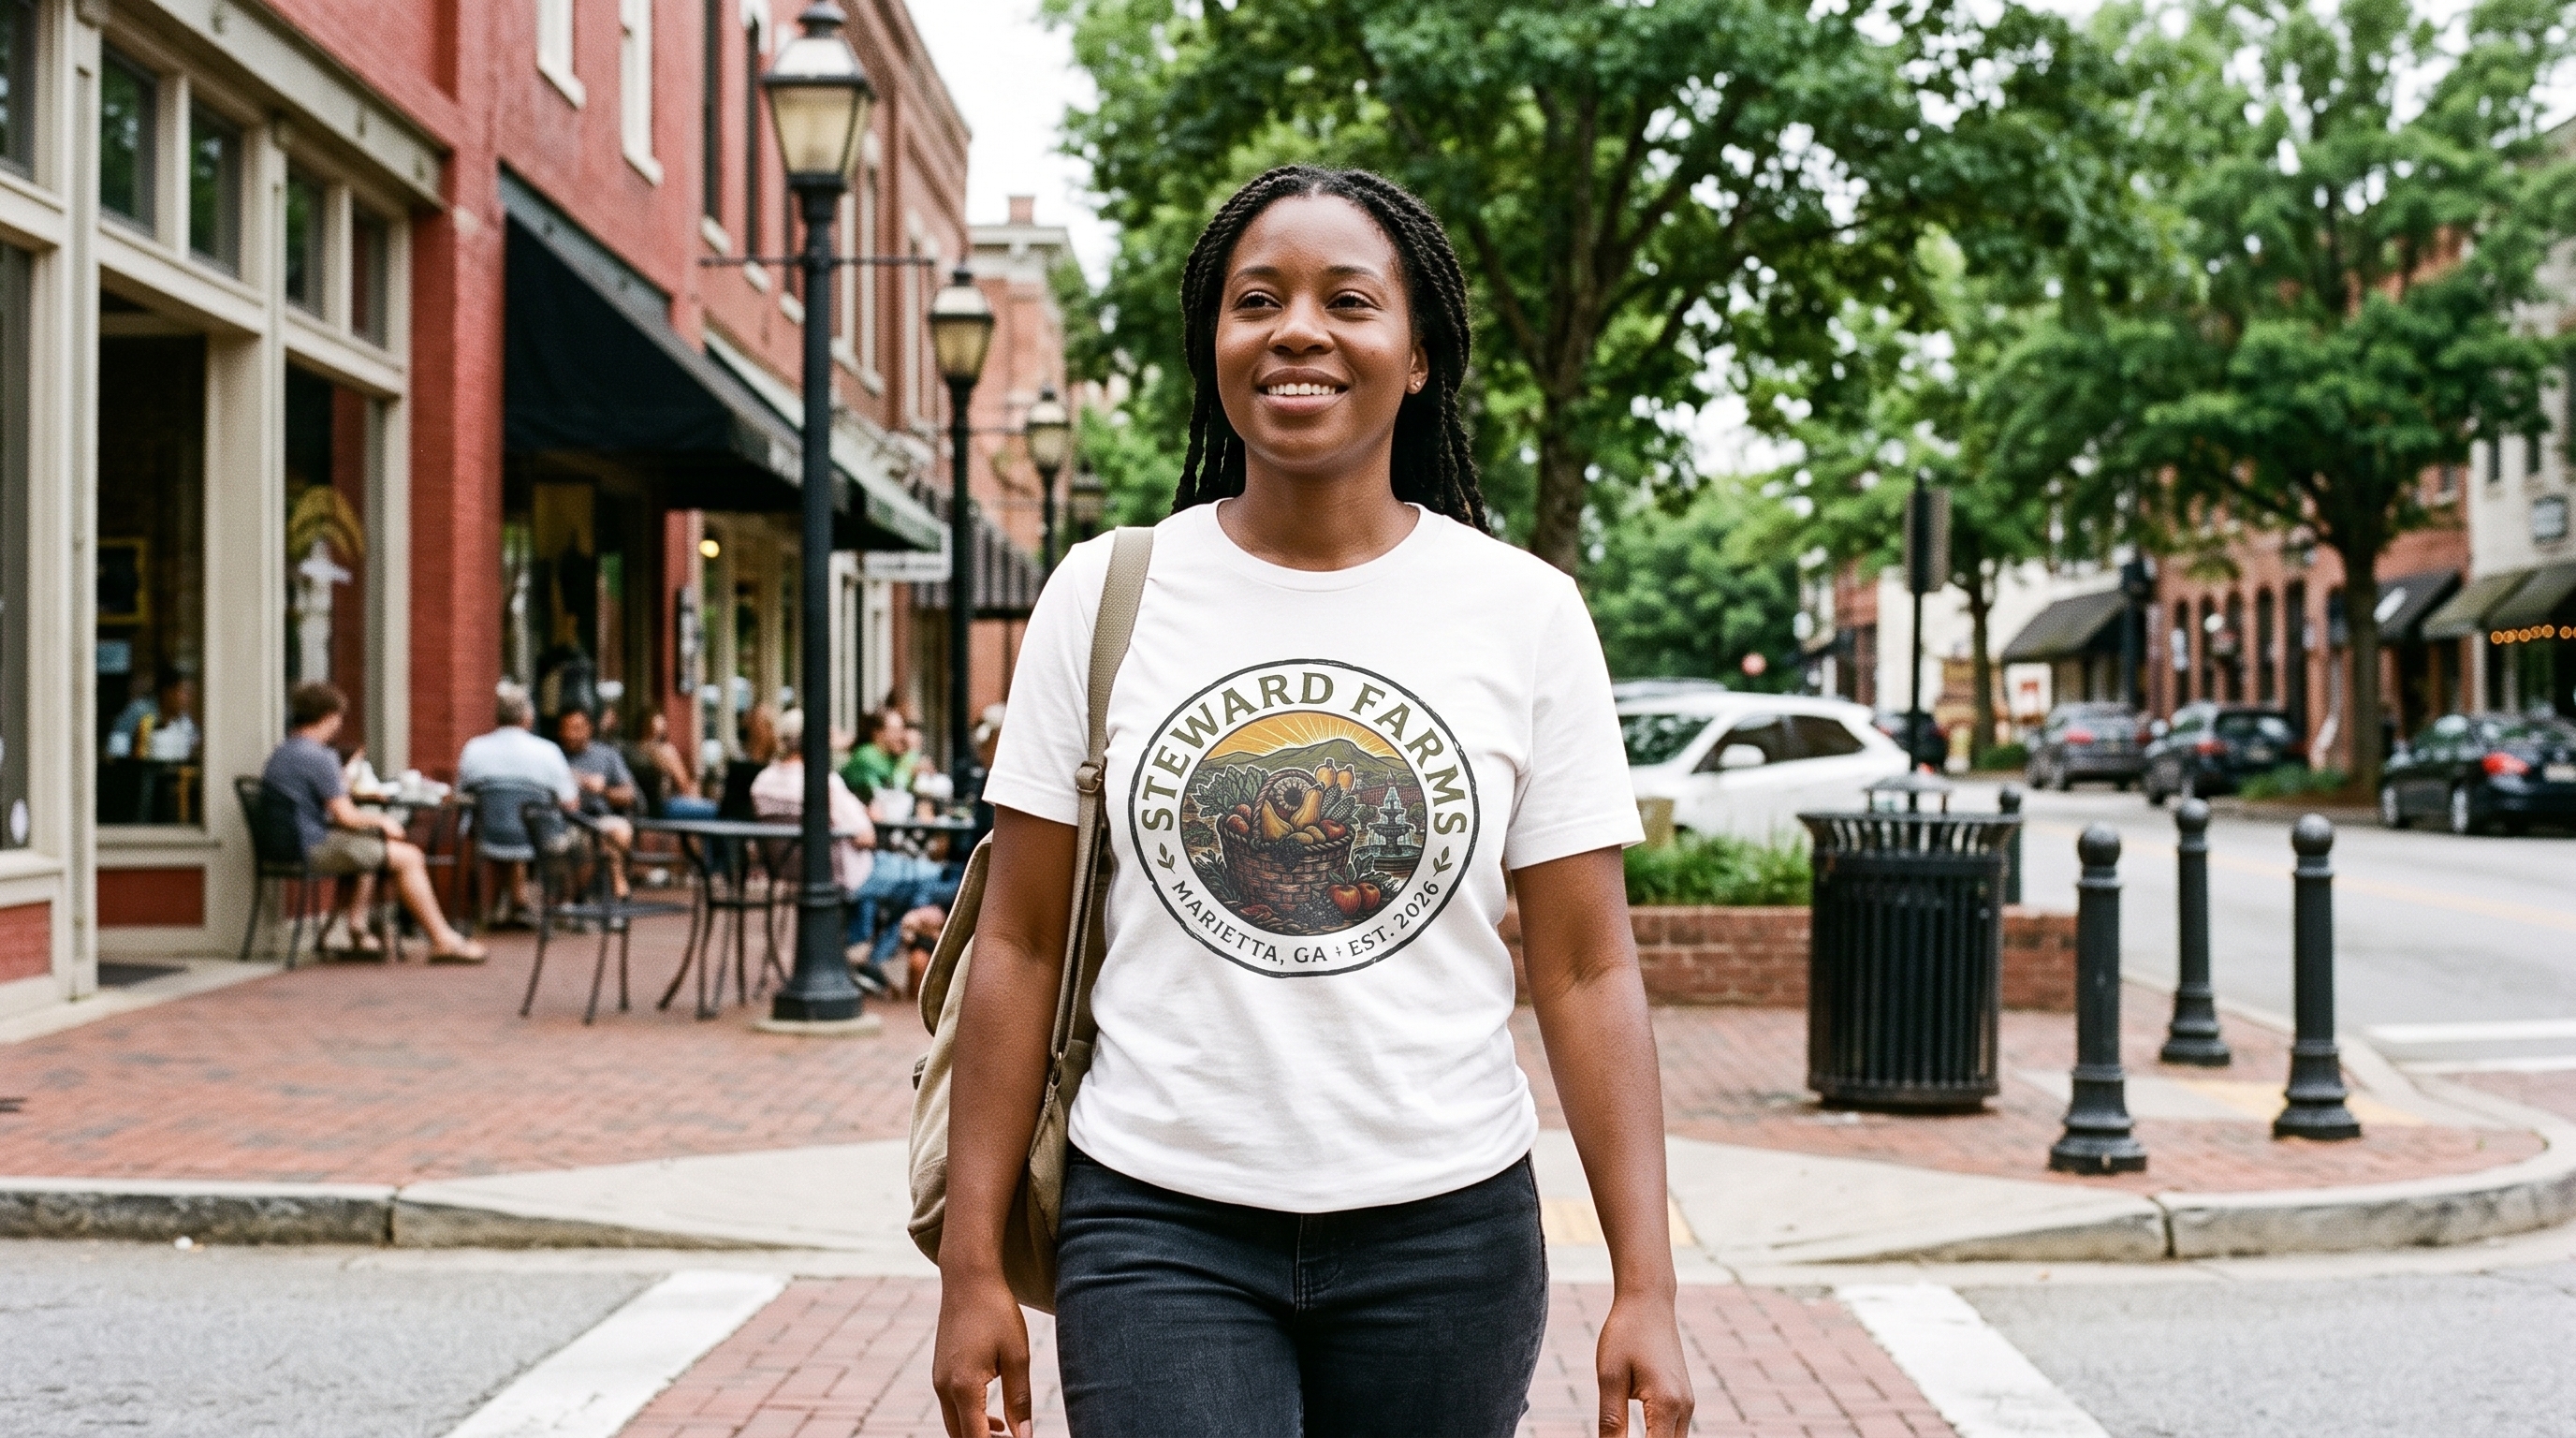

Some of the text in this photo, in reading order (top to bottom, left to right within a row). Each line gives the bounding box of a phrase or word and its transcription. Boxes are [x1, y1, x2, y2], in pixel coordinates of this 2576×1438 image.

[1142, 672, 1468, 834] STEWARD FARMS
[1172, 880, 1440, 965] MARIETTA, GA EST. 2026
